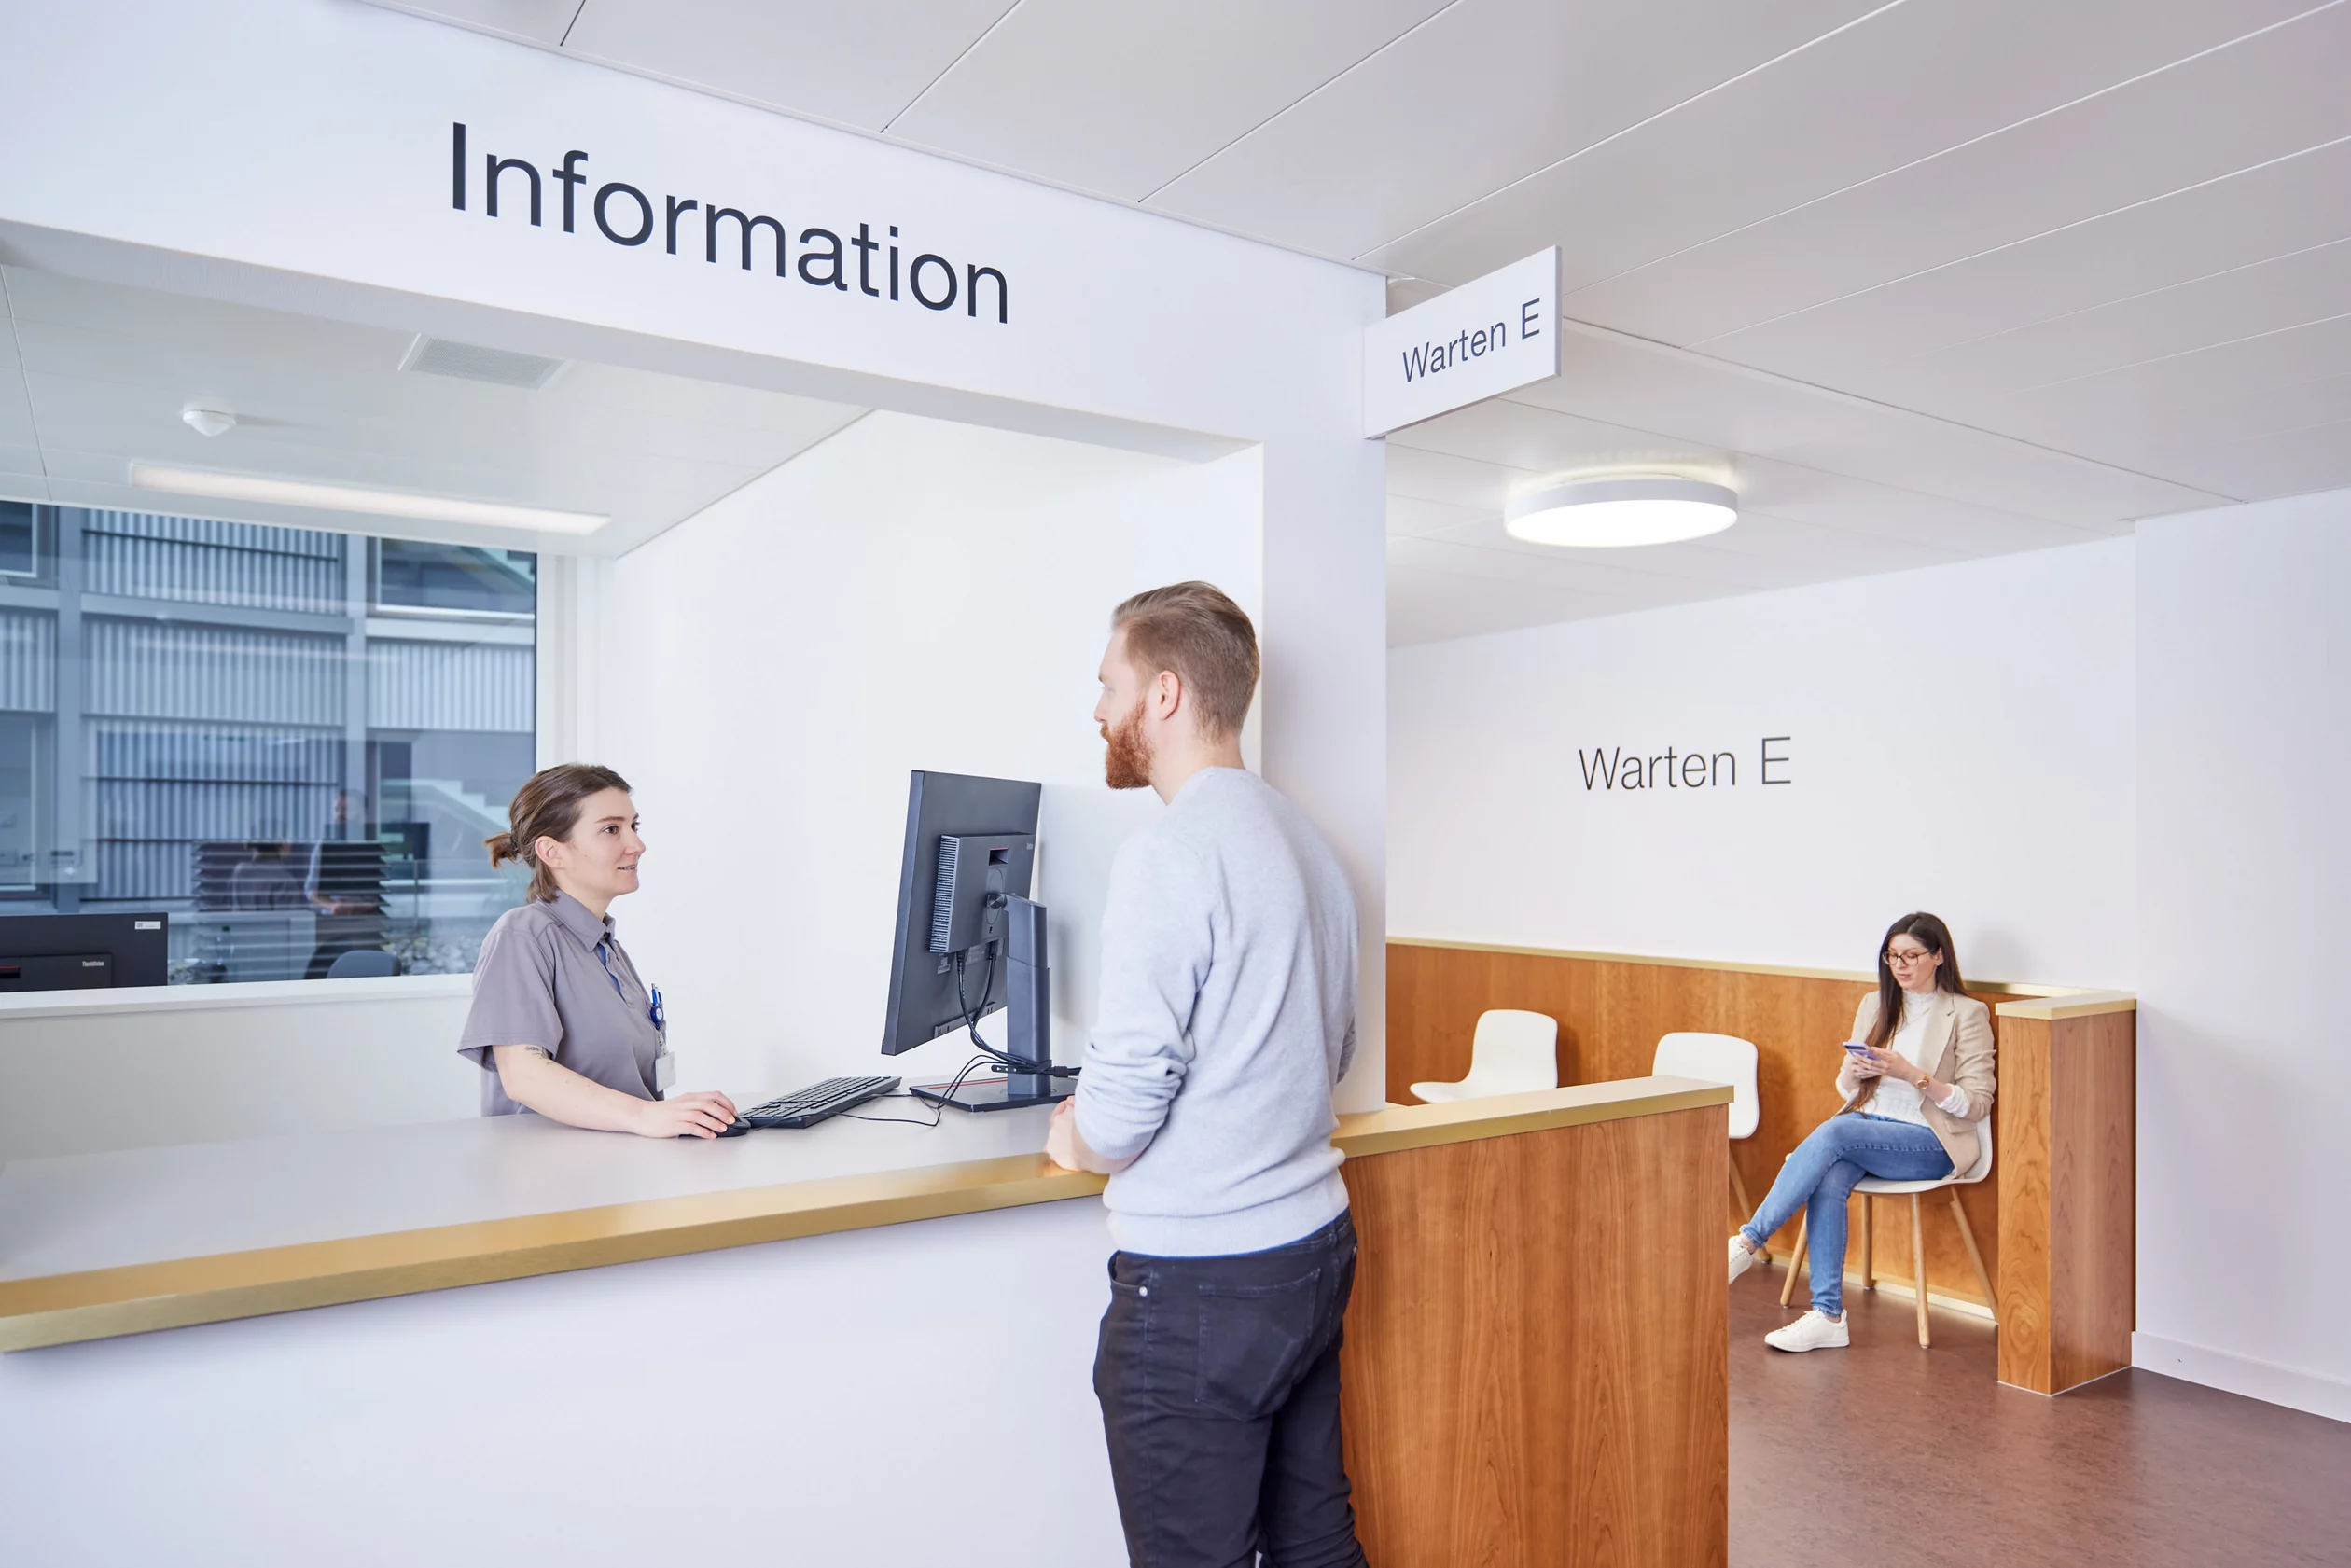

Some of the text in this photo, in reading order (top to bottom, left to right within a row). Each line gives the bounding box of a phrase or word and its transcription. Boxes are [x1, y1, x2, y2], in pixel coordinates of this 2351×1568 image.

[452, 121, 1008, 324] Information
[1402, 298, 1540, 382] Warten E
[1579, 736, 1791, 790] Warten E
